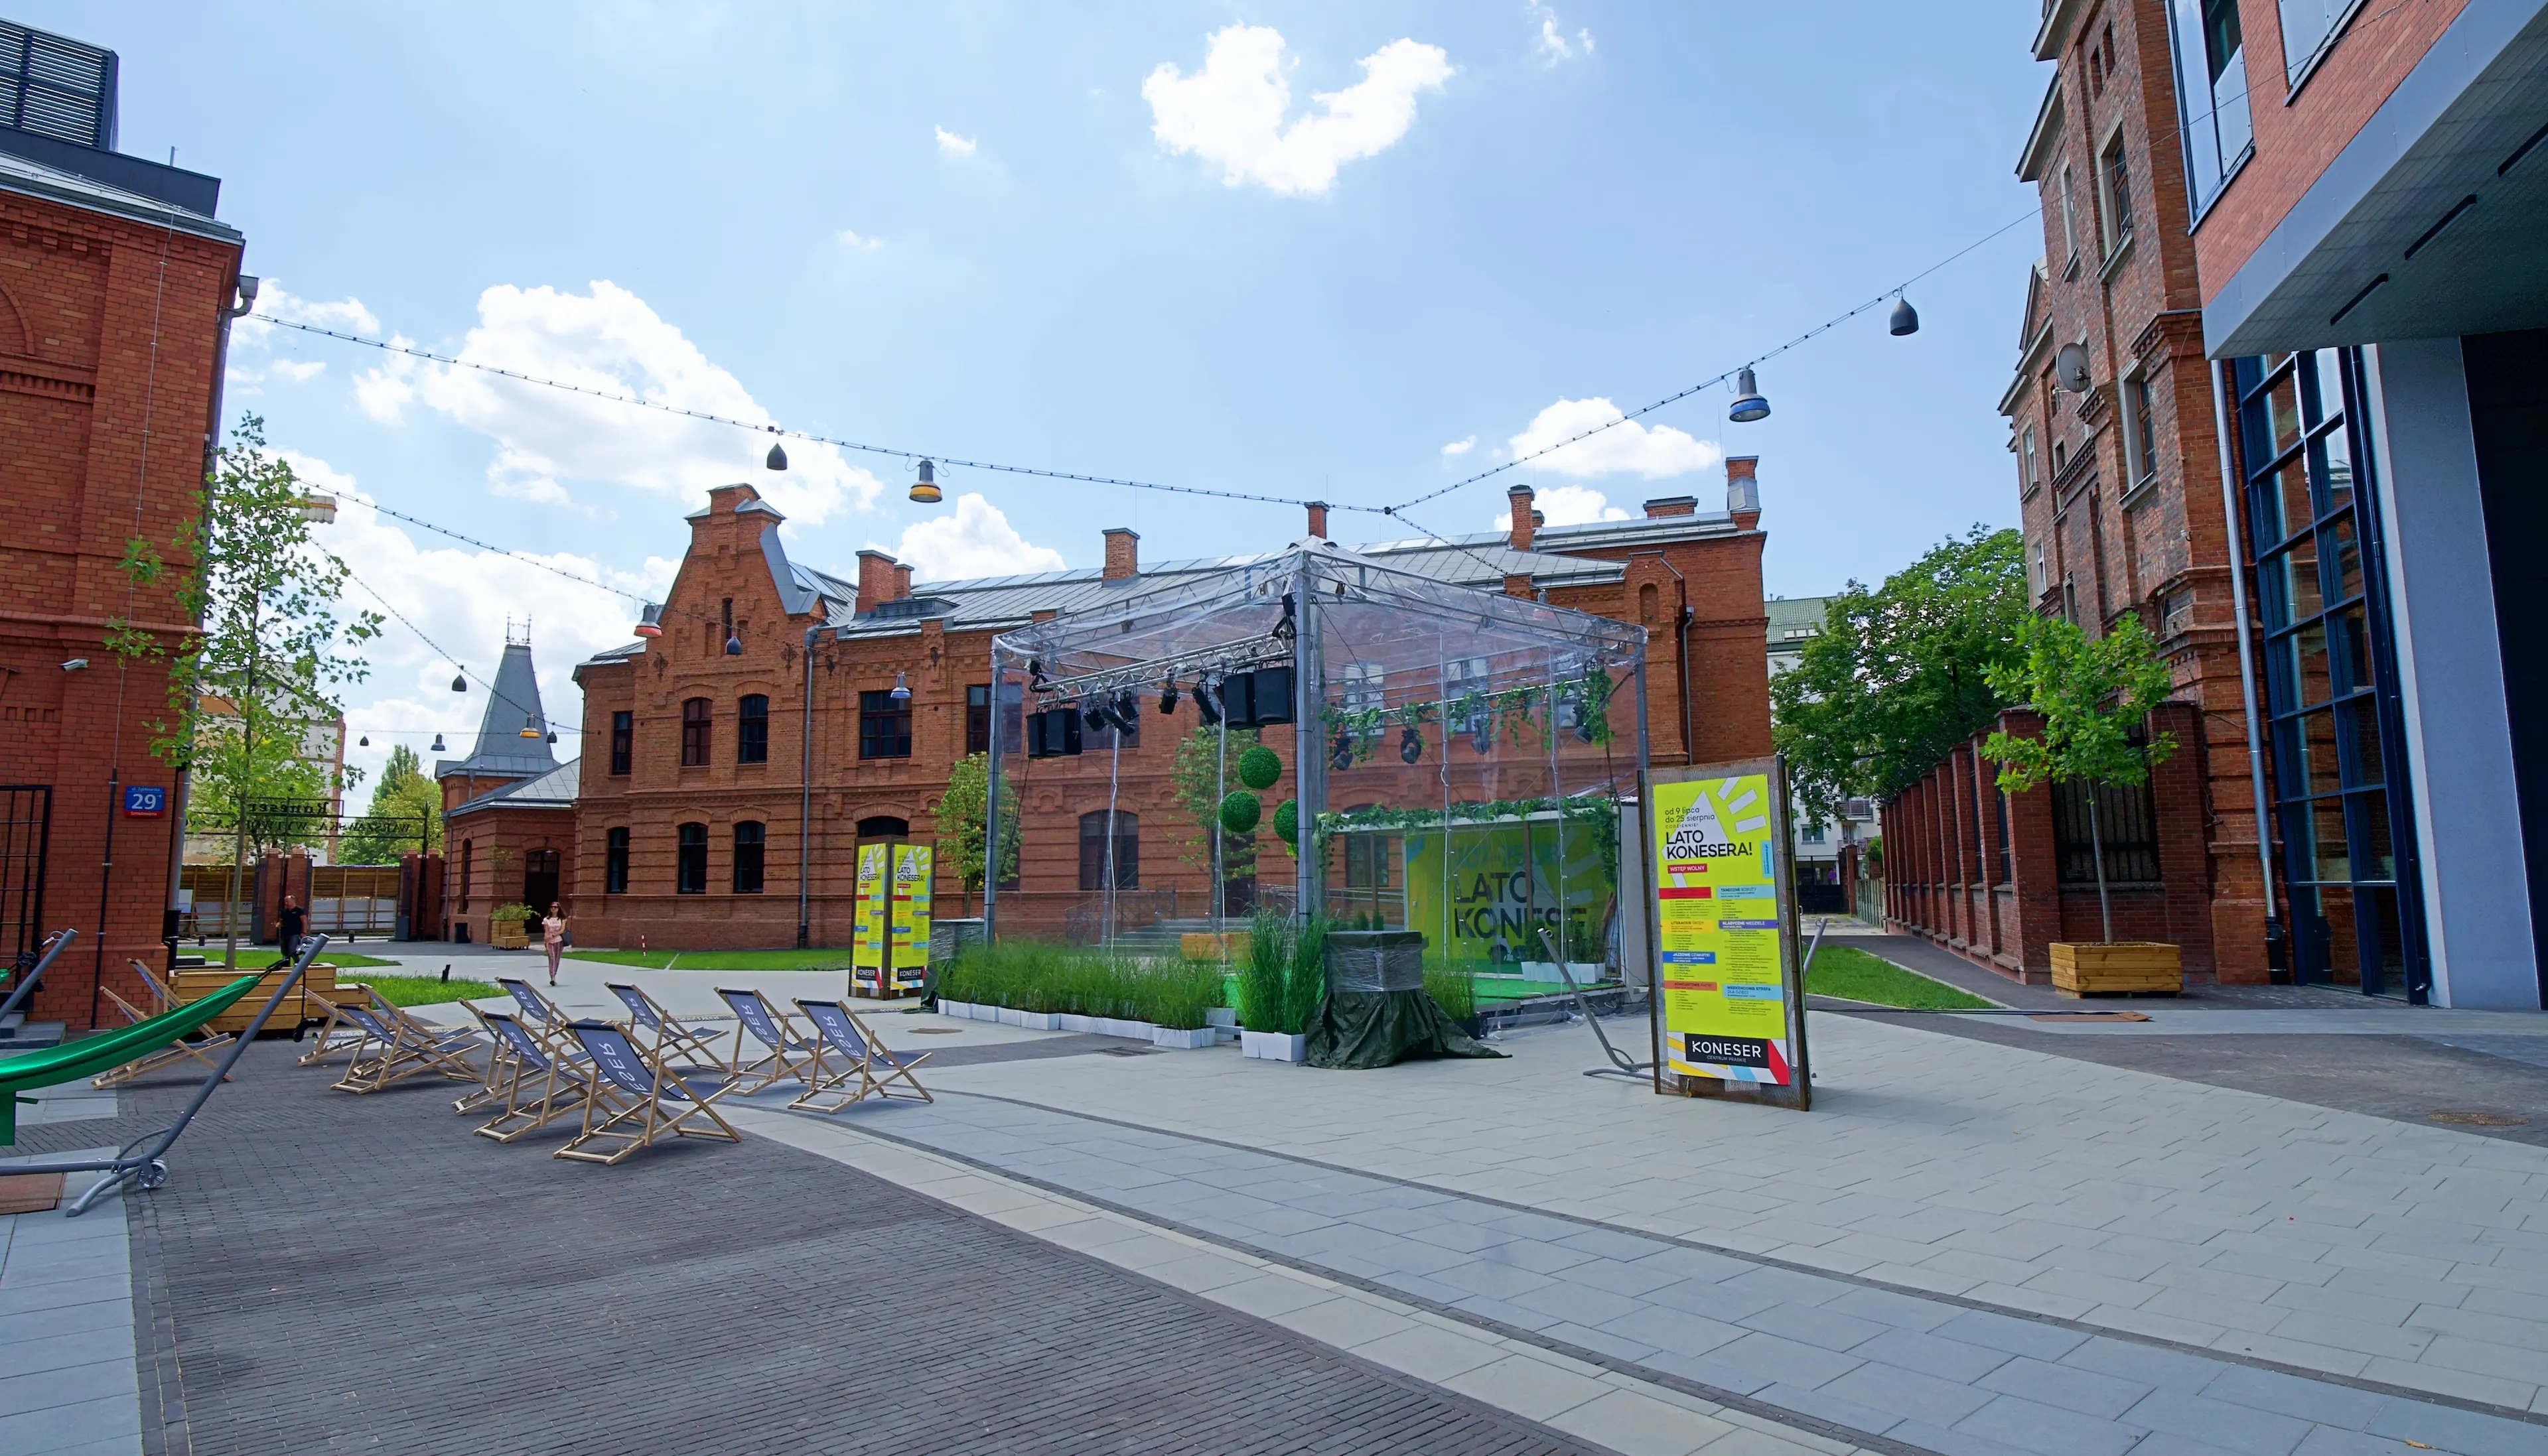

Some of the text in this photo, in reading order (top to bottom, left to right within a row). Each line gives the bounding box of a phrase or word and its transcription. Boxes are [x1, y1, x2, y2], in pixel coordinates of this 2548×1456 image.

[131, 793, 157, 810] 29
[1682, 807, 1700, 815] lipca
[1686, 813, 1715, 823] sierpnia
[1666, 830, 1704, 844] LATO
[1667, 842, 1752, 860] KONESERA!
[1454, 871, 1535, 903] LATO
[1691, 1040, 1762, 1058] KONESER
